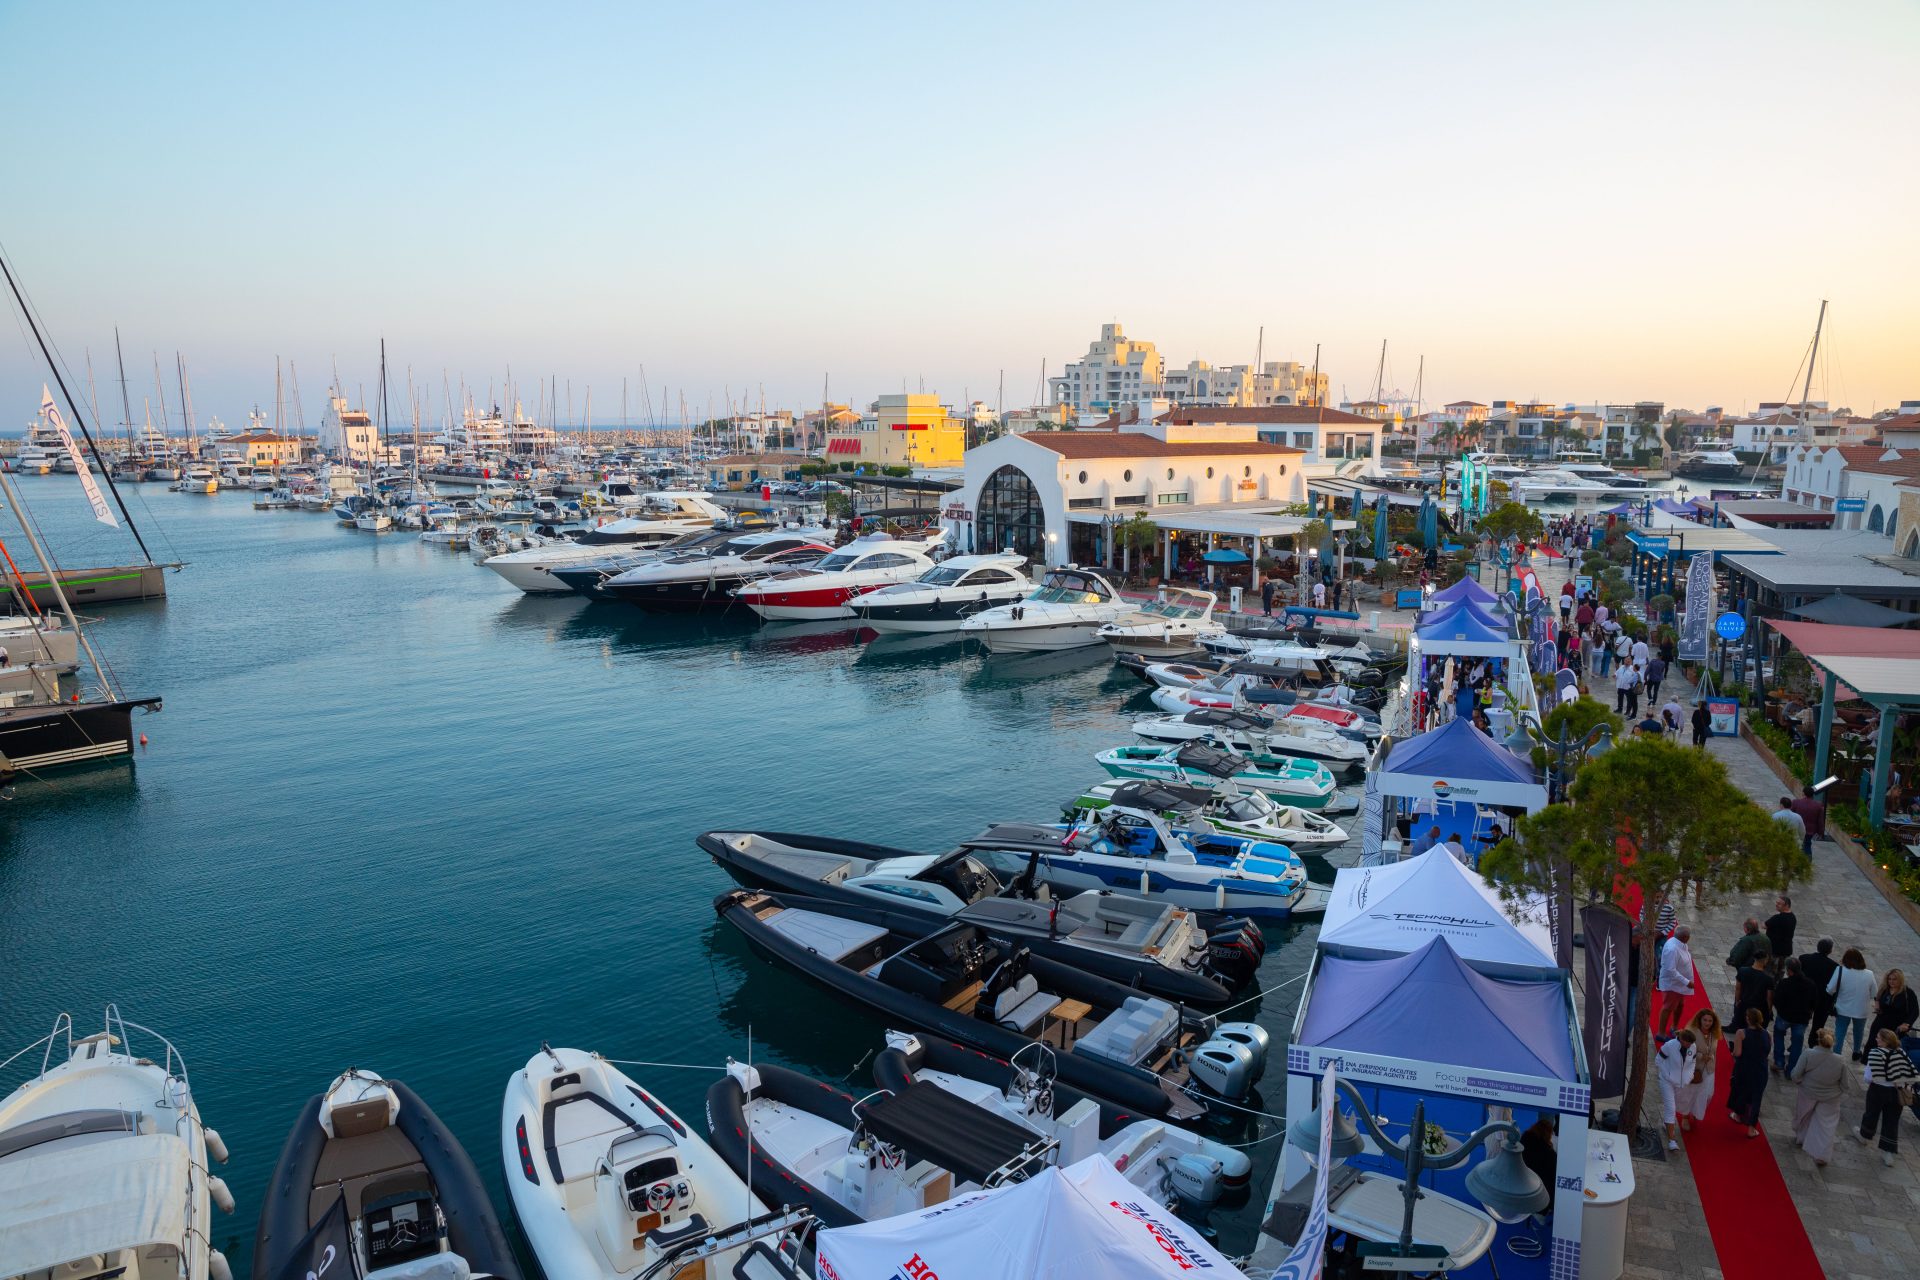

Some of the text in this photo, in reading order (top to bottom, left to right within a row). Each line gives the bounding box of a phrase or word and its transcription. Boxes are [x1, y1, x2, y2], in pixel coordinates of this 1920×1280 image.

[71, 447, 108, 518] YACHTS
[1393, 913, 1495, 926] TECHNOHULL
[1197, 1056, 1227, 1077] HONDA
[1351, 1067, 1382, 1077] INSURANCE
[1358, 1063, 1388, 1073] EVRIPIDOU
[1389, 1067, 1417, 1076] FACILITIES
[1450, 1085, 1472, 1094] handle
[1477, 1079, 1488, 1087] the
[1488, 1080, 1508, 1090] things
[1509, 1082, 1522, 1091] that
[1174, 1167, 1202, 1184] HONDA
[1124, 1202, 1214, 1268] MARINE
[1367, 1259, 1394, 1267] Shopping
